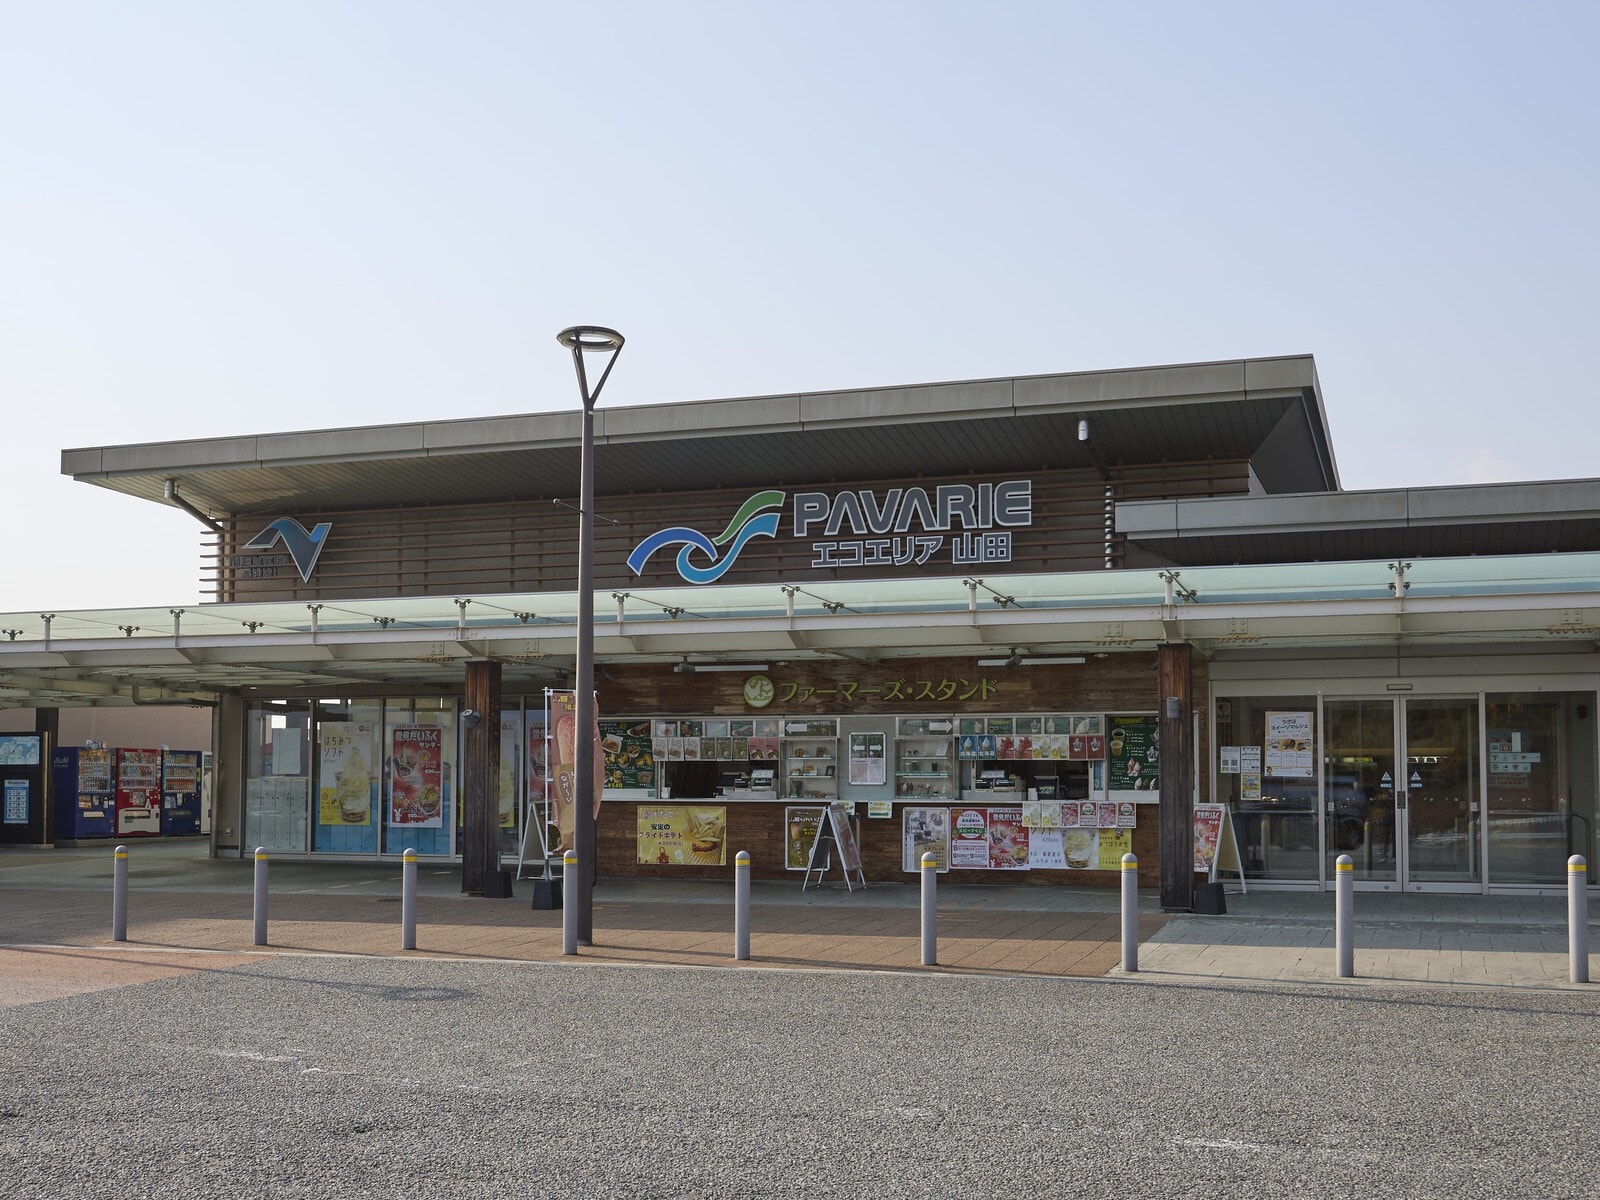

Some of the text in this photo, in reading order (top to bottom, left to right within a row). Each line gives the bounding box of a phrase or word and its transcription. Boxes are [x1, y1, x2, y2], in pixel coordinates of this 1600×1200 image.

[793, 479, 1032, 538] PAVARIE
[811, 531, 1012, 569] エコエリア 山田
[780, 678, 998, 703] ファーマーズ・スタンド
[323, 736, 352, 746] はちみつ
[323, 748, 344, 757] ソフト
[650, 823, 671, 831] 安定の
[639, 831, 683, 839] フライドポテト
